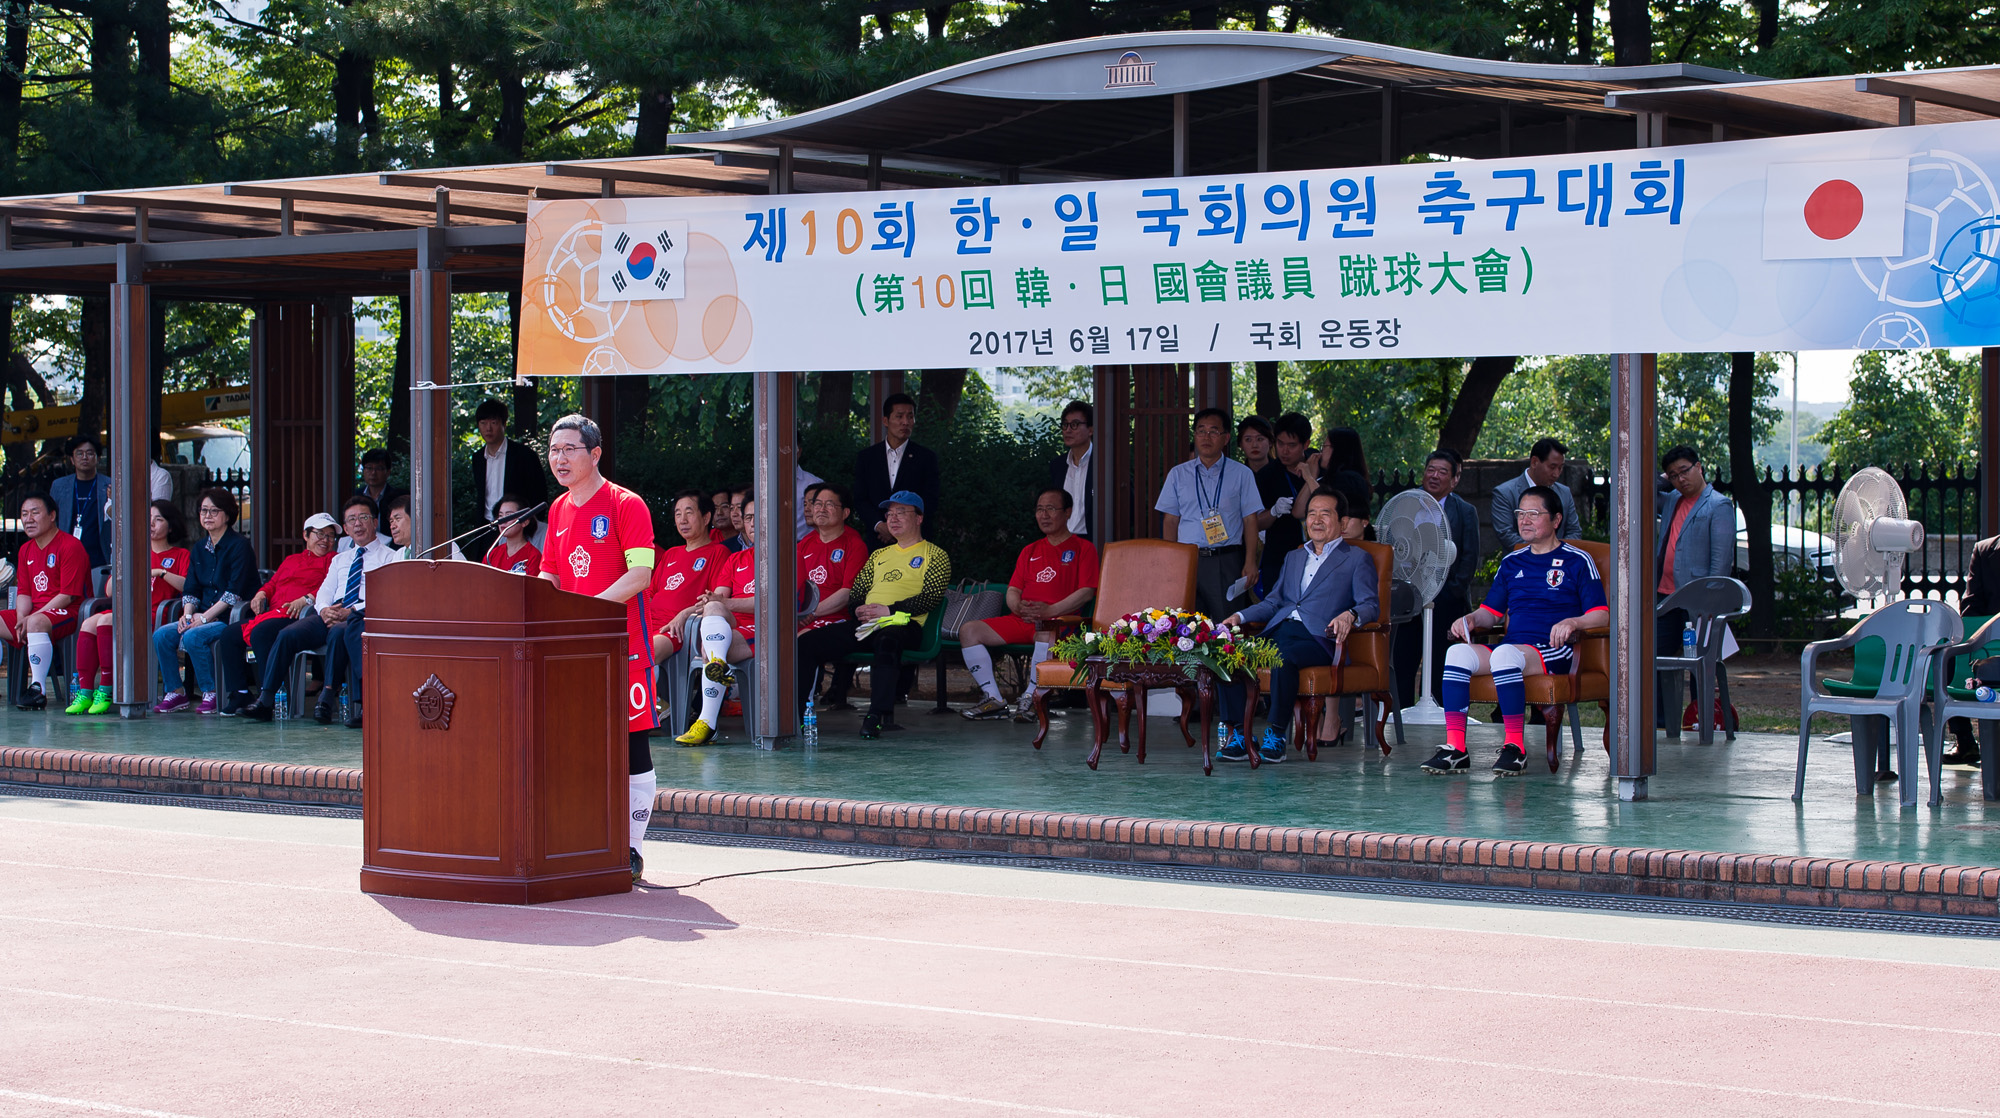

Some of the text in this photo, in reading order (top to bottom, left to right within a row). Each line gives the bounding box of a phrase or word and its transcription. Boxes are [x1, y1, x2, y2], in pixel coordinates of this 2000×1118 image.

[742, 200, 917, 263] 제10회
[1135, 174, 1378, 246] 국회의원
[1417, 158, 1686, 235] 축구대회
[855, 269, 995, 316] (第10回
[1152, 256, 1316, 305] 國會議員
[1338, 246, 1534, 298] 蹴球大會)
[969, 327, 1054, 356] 2017년
[1069, 325, 1111, 355] 6월
[1126, 324, 1180, 353] 17일
[1249, 320, 1302, 351] 국회
[1318, 317, 1403, 349] 운동장
[225, 394, 250, 402] TADAN
